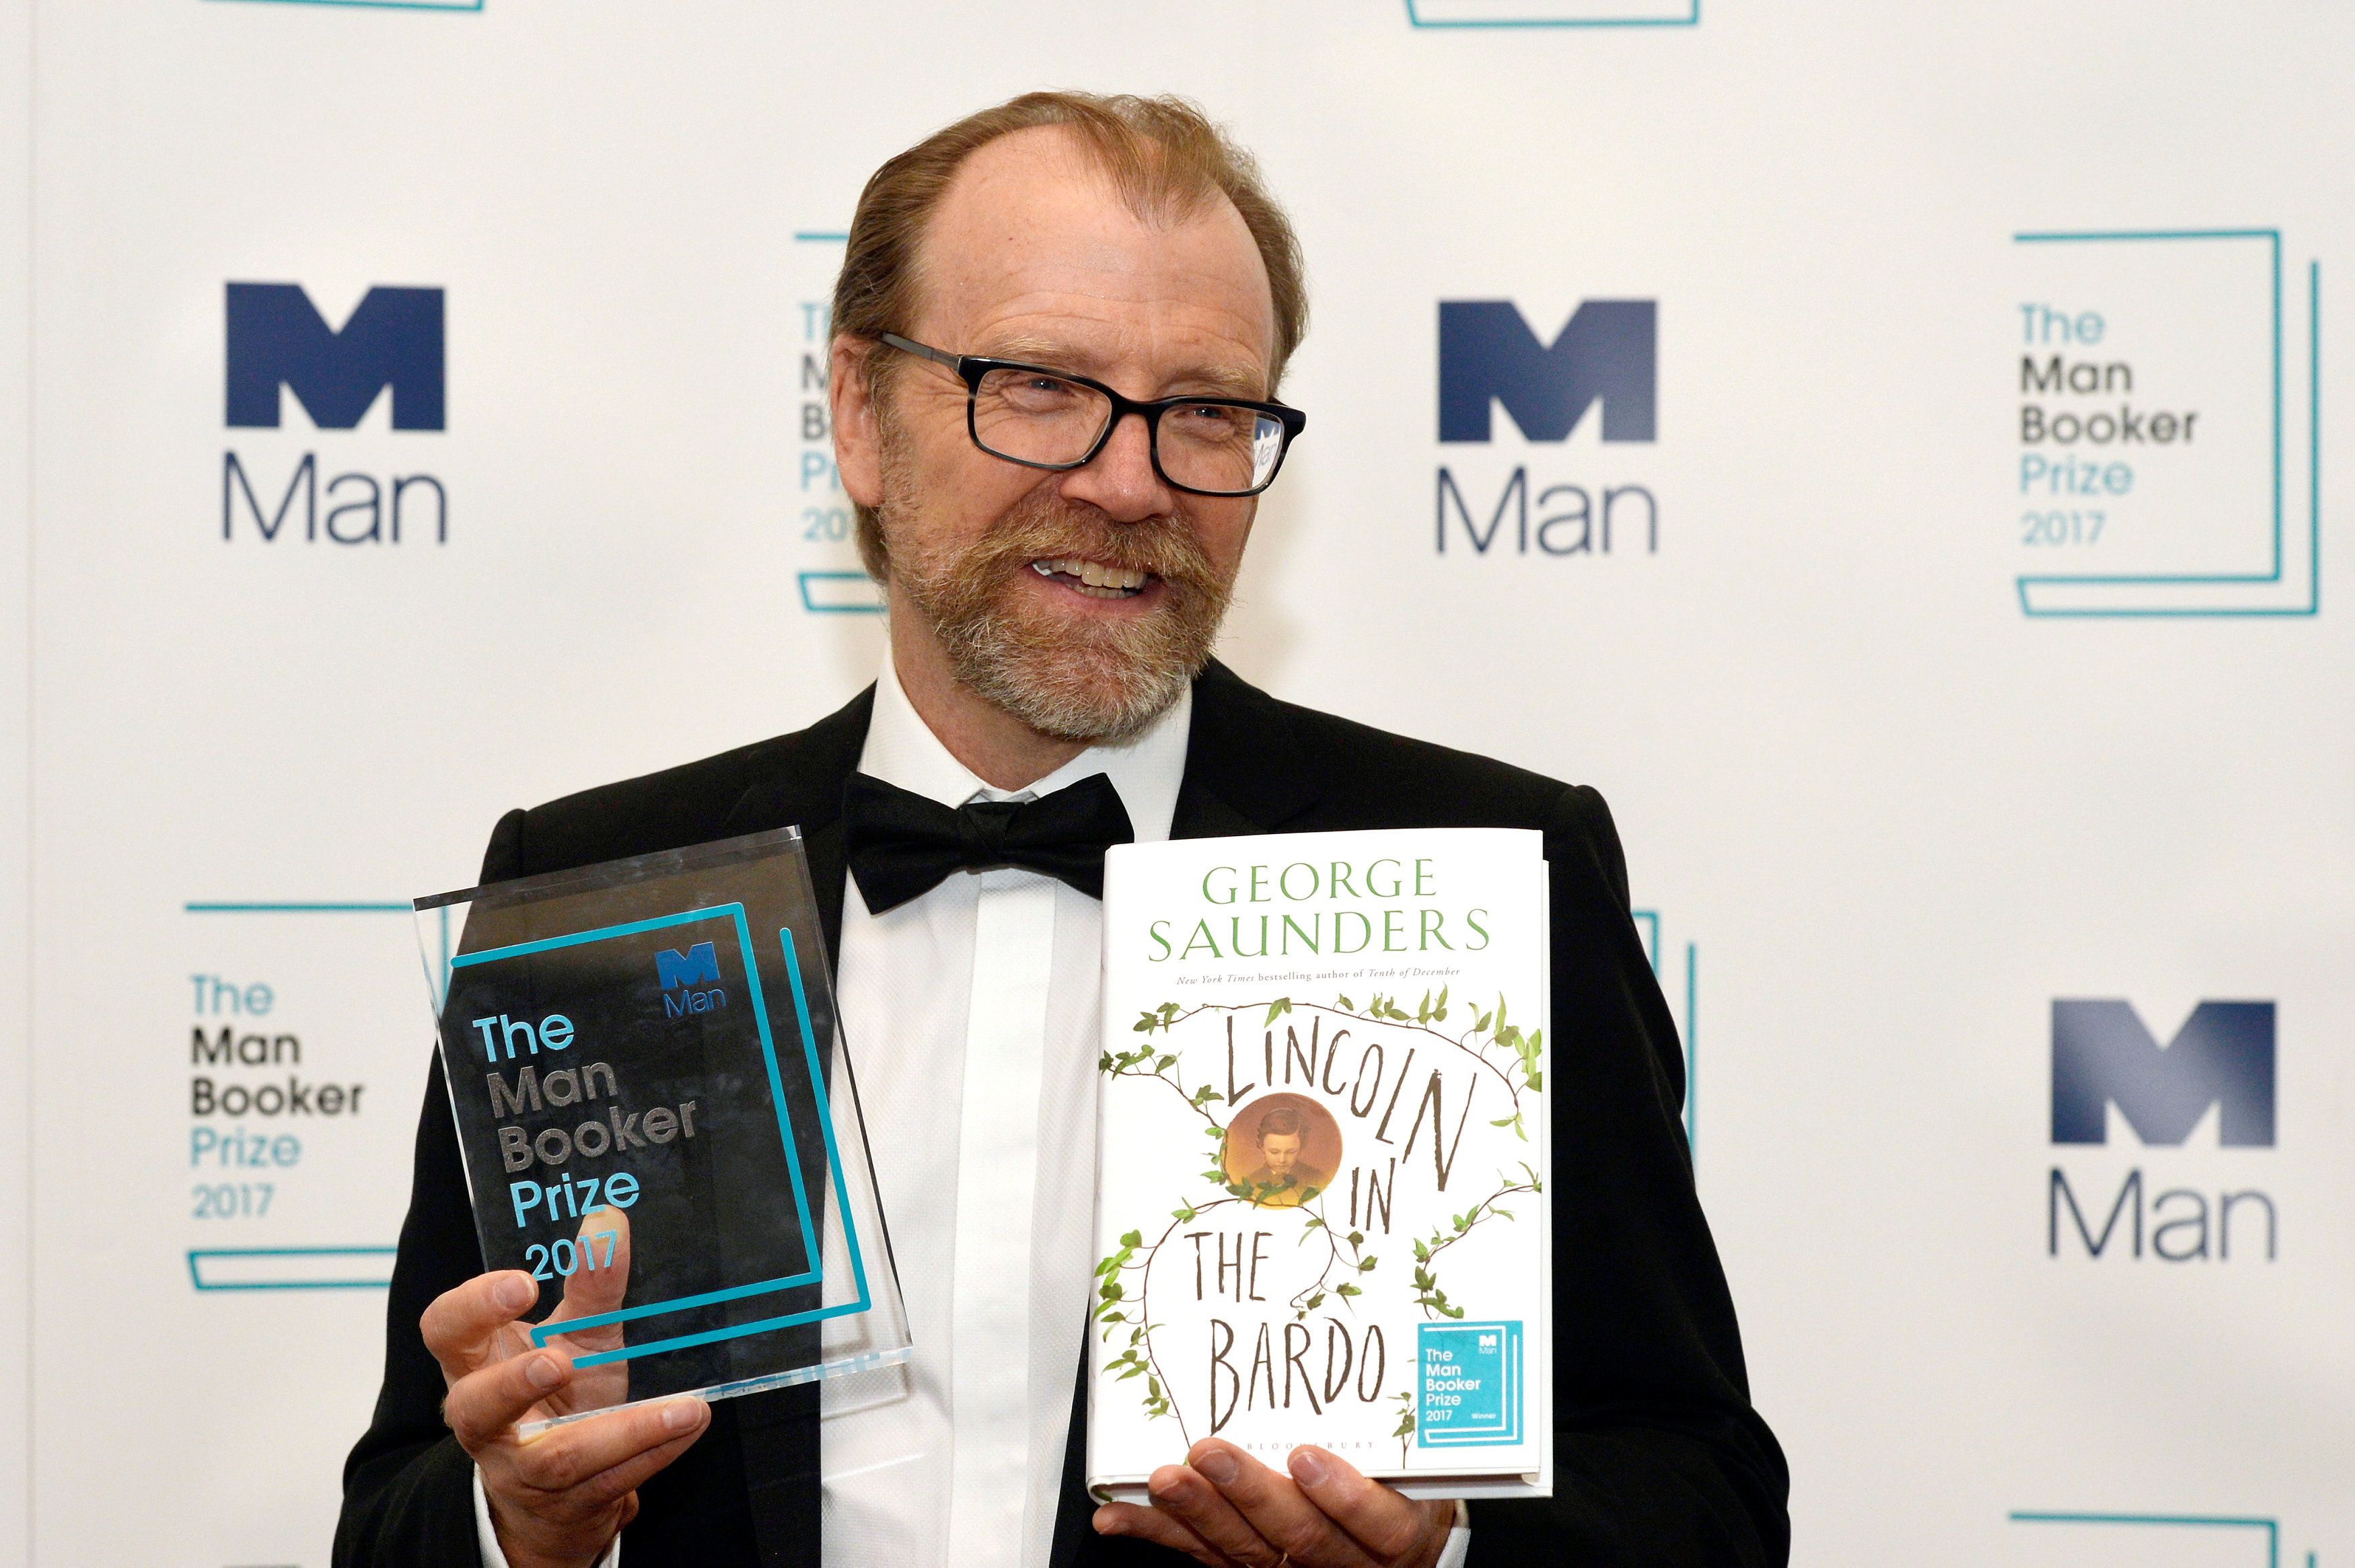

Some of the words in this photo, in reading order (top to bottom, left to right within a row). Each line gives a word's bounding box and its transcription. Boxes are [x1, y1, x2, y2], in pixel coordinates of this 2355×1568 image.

[2019, 303, 2106, 345] The
[2021, 354, 2132, 394] Man
[2020, 404, 2198, 445] Booker
[2020, 453, 2134, 496] Prize
[223, 450, 447, 545] Man
[1436, 465, 1657, 556] Man
[2021, 510, 2107, 546] 2017
[1202, 858, 1437, 905] GEORGE
[1149, 908, 1490, 962] SAUNDERS
[190, 973, 275, 1016] The
[1177, 977, 1197, 985] New
[1202, 975, 1223, 983] York
[1227, 974, 1255, 982] Times
[1258, 972, 1311, 981] bestselling
[1316, 969, 1348, 979] author
[1353, 969, 1365, 977] of
[1369, 968, 1395, 977] Tenth
[1399, 967, 1411, 978] of
[1413, 967, 1461, 976] December
[663, 989, 726, 1018] Man
[192, 1026, 300, 1066] Man
[472, 1014, 575, 1063] The
[191, 1076, 363, 1117] Booker
[486, 1061, 618, 1119] Man
[1226, 1015, 1478, 1192] LINCOLN
[190, 1125, 301, 1168] Prize
[498, 1100, 697, 1173] Booker
[191, 1183, 275, 1220] 2017
[510, 1172, 640, 1228] Prize
[1350, 1157, 1396, 1235] IN
[2048, 1166, 2276, 1262] Man
[526, 1230, 617, 1281] 2017
[1184, 1232, 1274, 1304] THE
[1210, 1317, 1386, 1436] BARDO
[1425, 1349, 1453, 1362] The
[1425, 1364, 1461, 1376] Man
[1425, 1378, 1482, 1392] Booker
[1425, 1393, 1461, 1407] Prize
[1425, 1410, 1453, 1421] 2017
[1247, 1442, 1375, 1450] BLOOBURY
